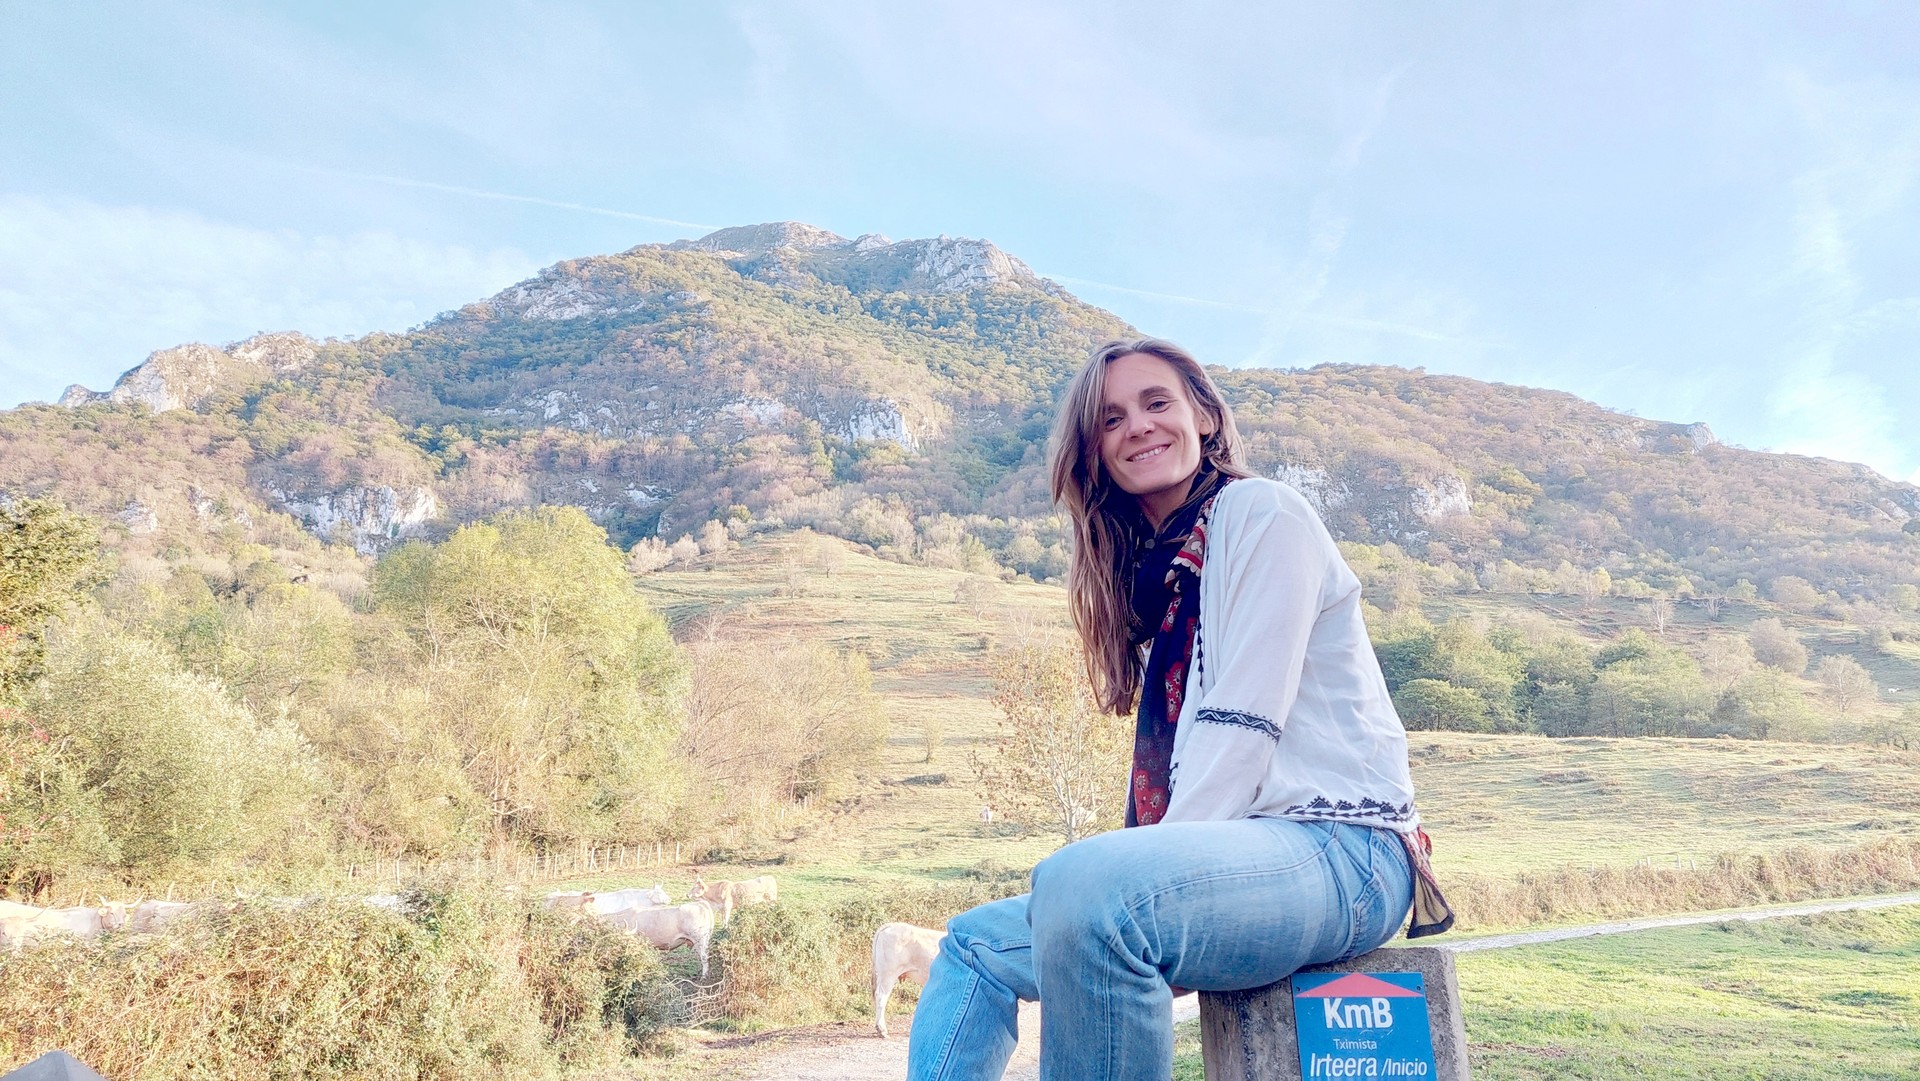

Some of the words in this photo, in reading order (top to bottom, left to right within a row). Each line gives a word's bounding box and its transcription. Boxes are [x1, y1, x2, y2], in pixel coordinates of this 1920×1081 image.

[1323, 997, 1393, 1029] KmB
[1333, 1038, 1377, 1050] Tximista
[1310, 1053, 1377, 1077] Irteera
